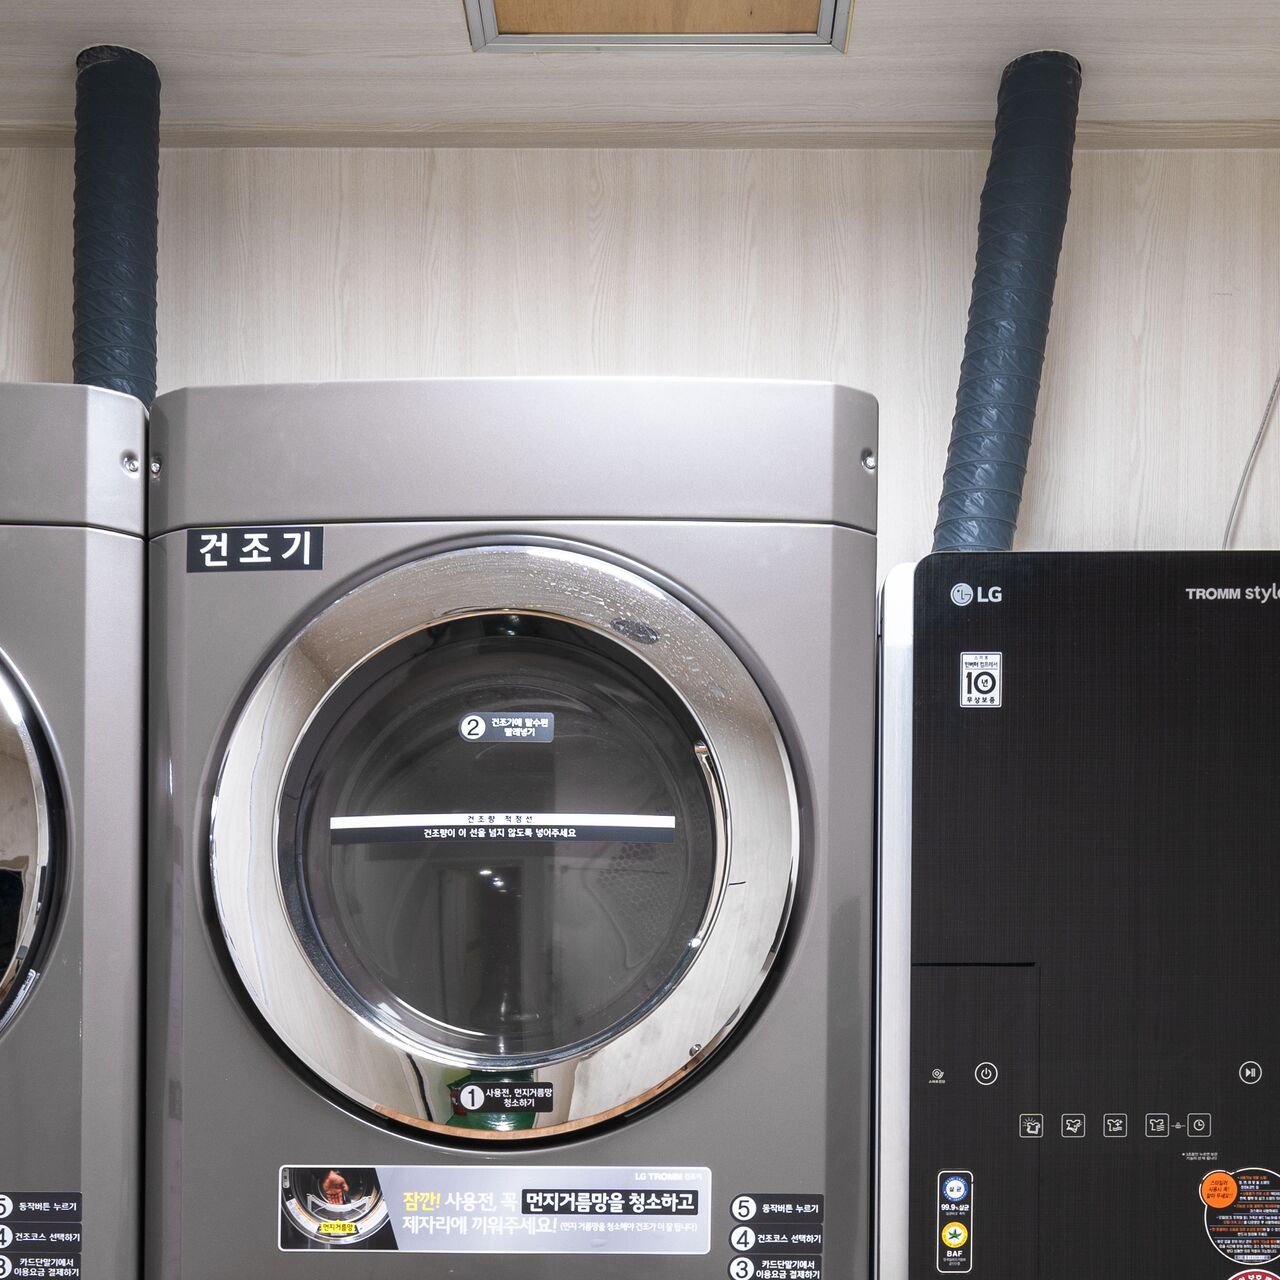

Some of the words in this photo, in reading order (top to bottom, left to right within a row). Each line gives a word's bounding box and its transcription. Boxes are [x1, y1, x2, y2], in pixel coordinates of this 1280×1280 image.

[199, 531, 310, 567] 건조기
[1186, 588, 1241, 600] TROMM
[423, 828, 456, 839] 건조량이
[458, 828, 467, 839] 이
[469, 828, 486, 839] 선을
[488, 828, 505, 838] 넘지
[508, 828, 533, 839] 않도록
[535, 828, 577, 838] 넣어주세요
[514, 1088, 553, 1098] 먼지거름망
[503, 1098, 535, 1107] 청소하기
[403, 1191, 441, 1211] 잠깐!
[500, 1192, 517, 1212] 꼭
[526, 1192, 625, 1213] 먼지거름망을
[629, 1193, 695, 1213] 청소하고
[323, 1223, 355, 1233] 먼지거름망
[403, 1215, 467, 1235] 제자리에
[471, 1215, 557, 1236] 끼워주세요!
